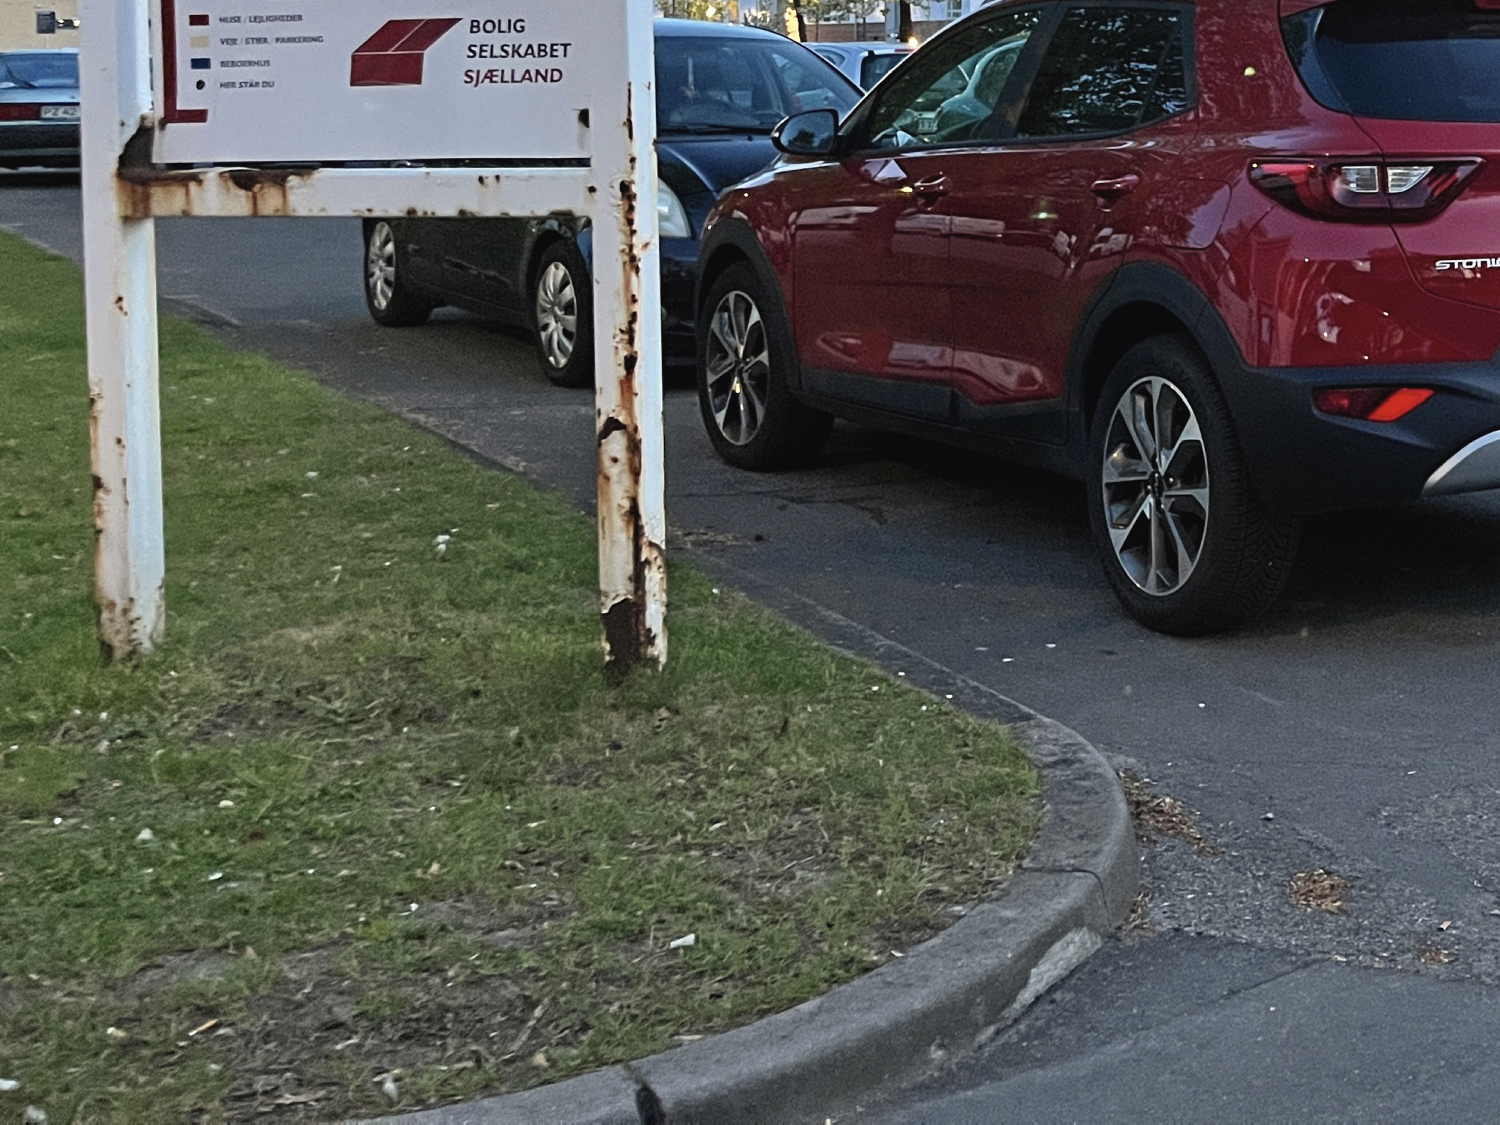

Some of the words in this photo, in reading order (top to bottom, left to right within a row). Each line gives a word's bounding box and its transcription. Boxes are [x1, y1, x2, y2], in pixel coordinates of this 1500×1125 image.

[469, 19, 525, 34] BOLIG
[467, 43, 572, 59] SELSKABET
[464, 68, 563, 88] SJÆLLAND
